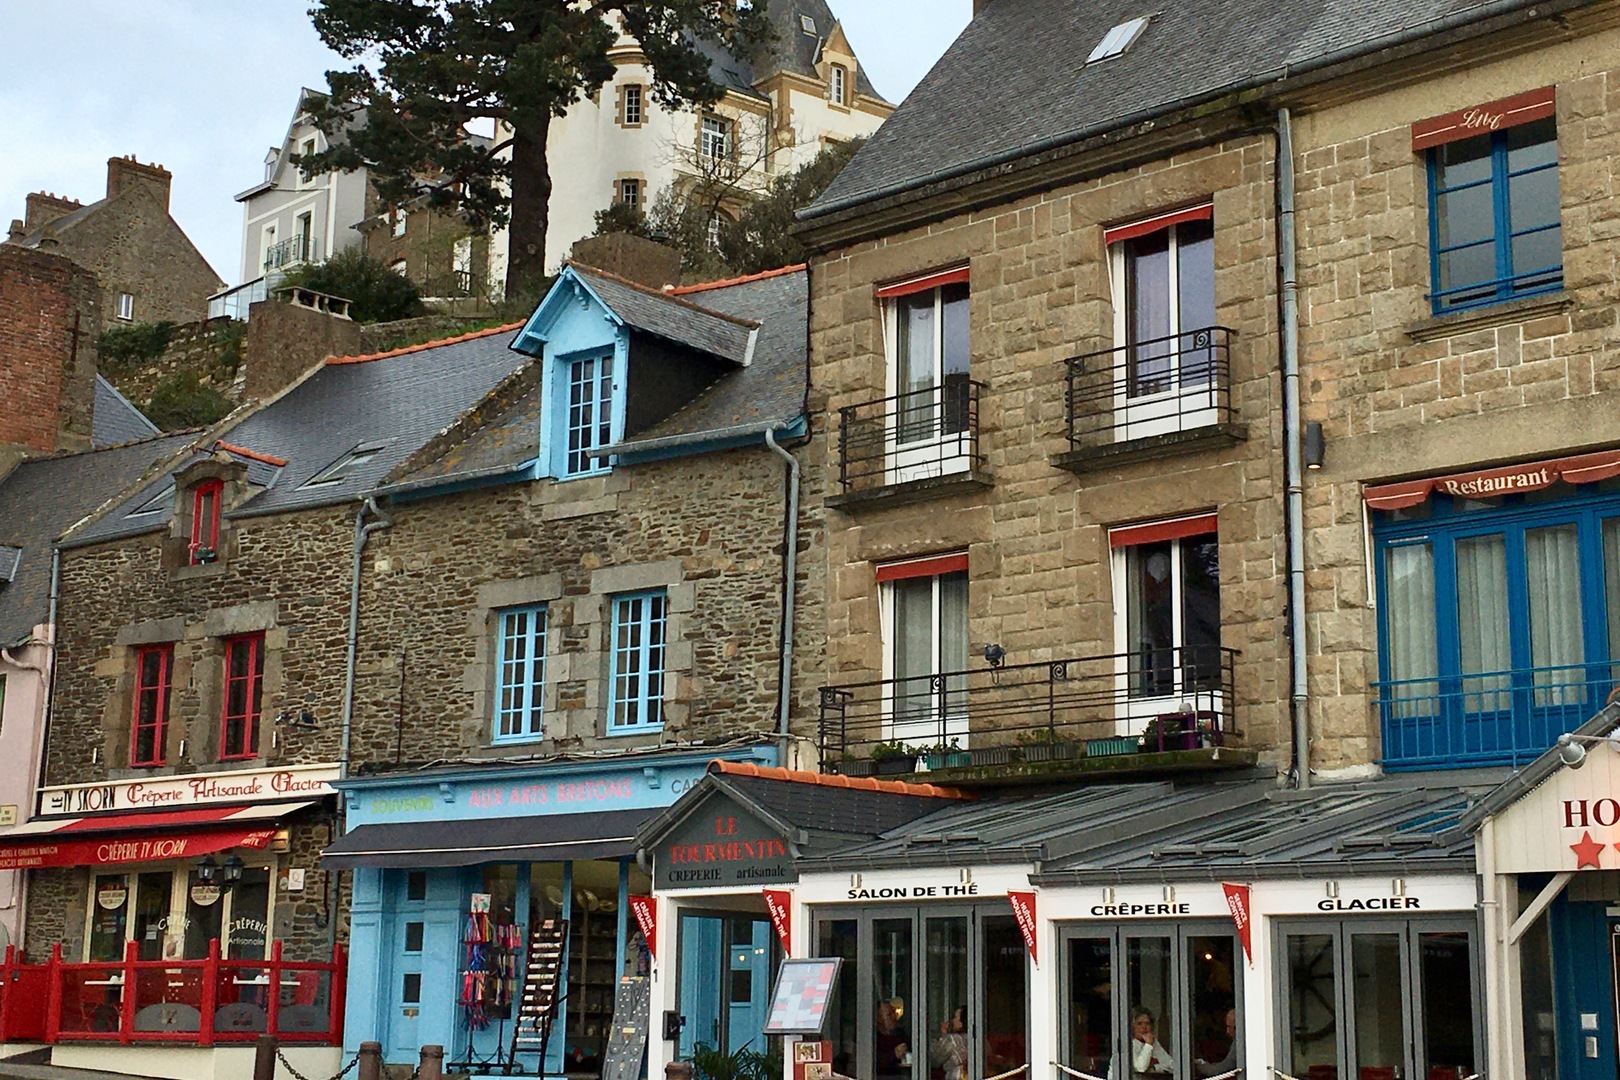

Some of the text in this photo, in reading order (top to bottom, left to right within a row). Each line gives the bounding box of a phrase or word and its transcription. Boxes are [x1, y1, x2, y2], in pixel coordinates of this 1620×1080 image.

[1444, 467, 1549, 495] Restaurant
[63, 790, 73, 812] TY
[77, 786, 116, 811] SKORN
[127, 783, 183, 806] Crêperie
[188, 778, 263, 802] Artisanale
[271, 771, 324, 796] Glacier
[467, 778, 632, 808] AUX ARTS BRETONS
[715, 815, 739, 836] LE
[97, 840, 139, 862] CRÊPERIE
[150, 839, 187, 858] SKORN
[670, 837, 787, 864] TOURMENTIN
[736, 864, 786, 879] artisanale
[847, 882, 978, 899] SALON DE THÉ
[1317, 897, 1421, 911] GLACIER
[639, 901, 655, 930] CRÊPERIE
[766, 894, 778, 917] SALON
[777, 905, 787, 920] BAR
[1090, 902, 1190, 916] CRÊPERIE
[1227, 895, 1244, 930] CONTINU
[1234, 892, 1248, 923] SERVICE
[632, 901, 651, 938] ARTISANALE
[1010, 895, 1034, 947] MOULES FRITES
